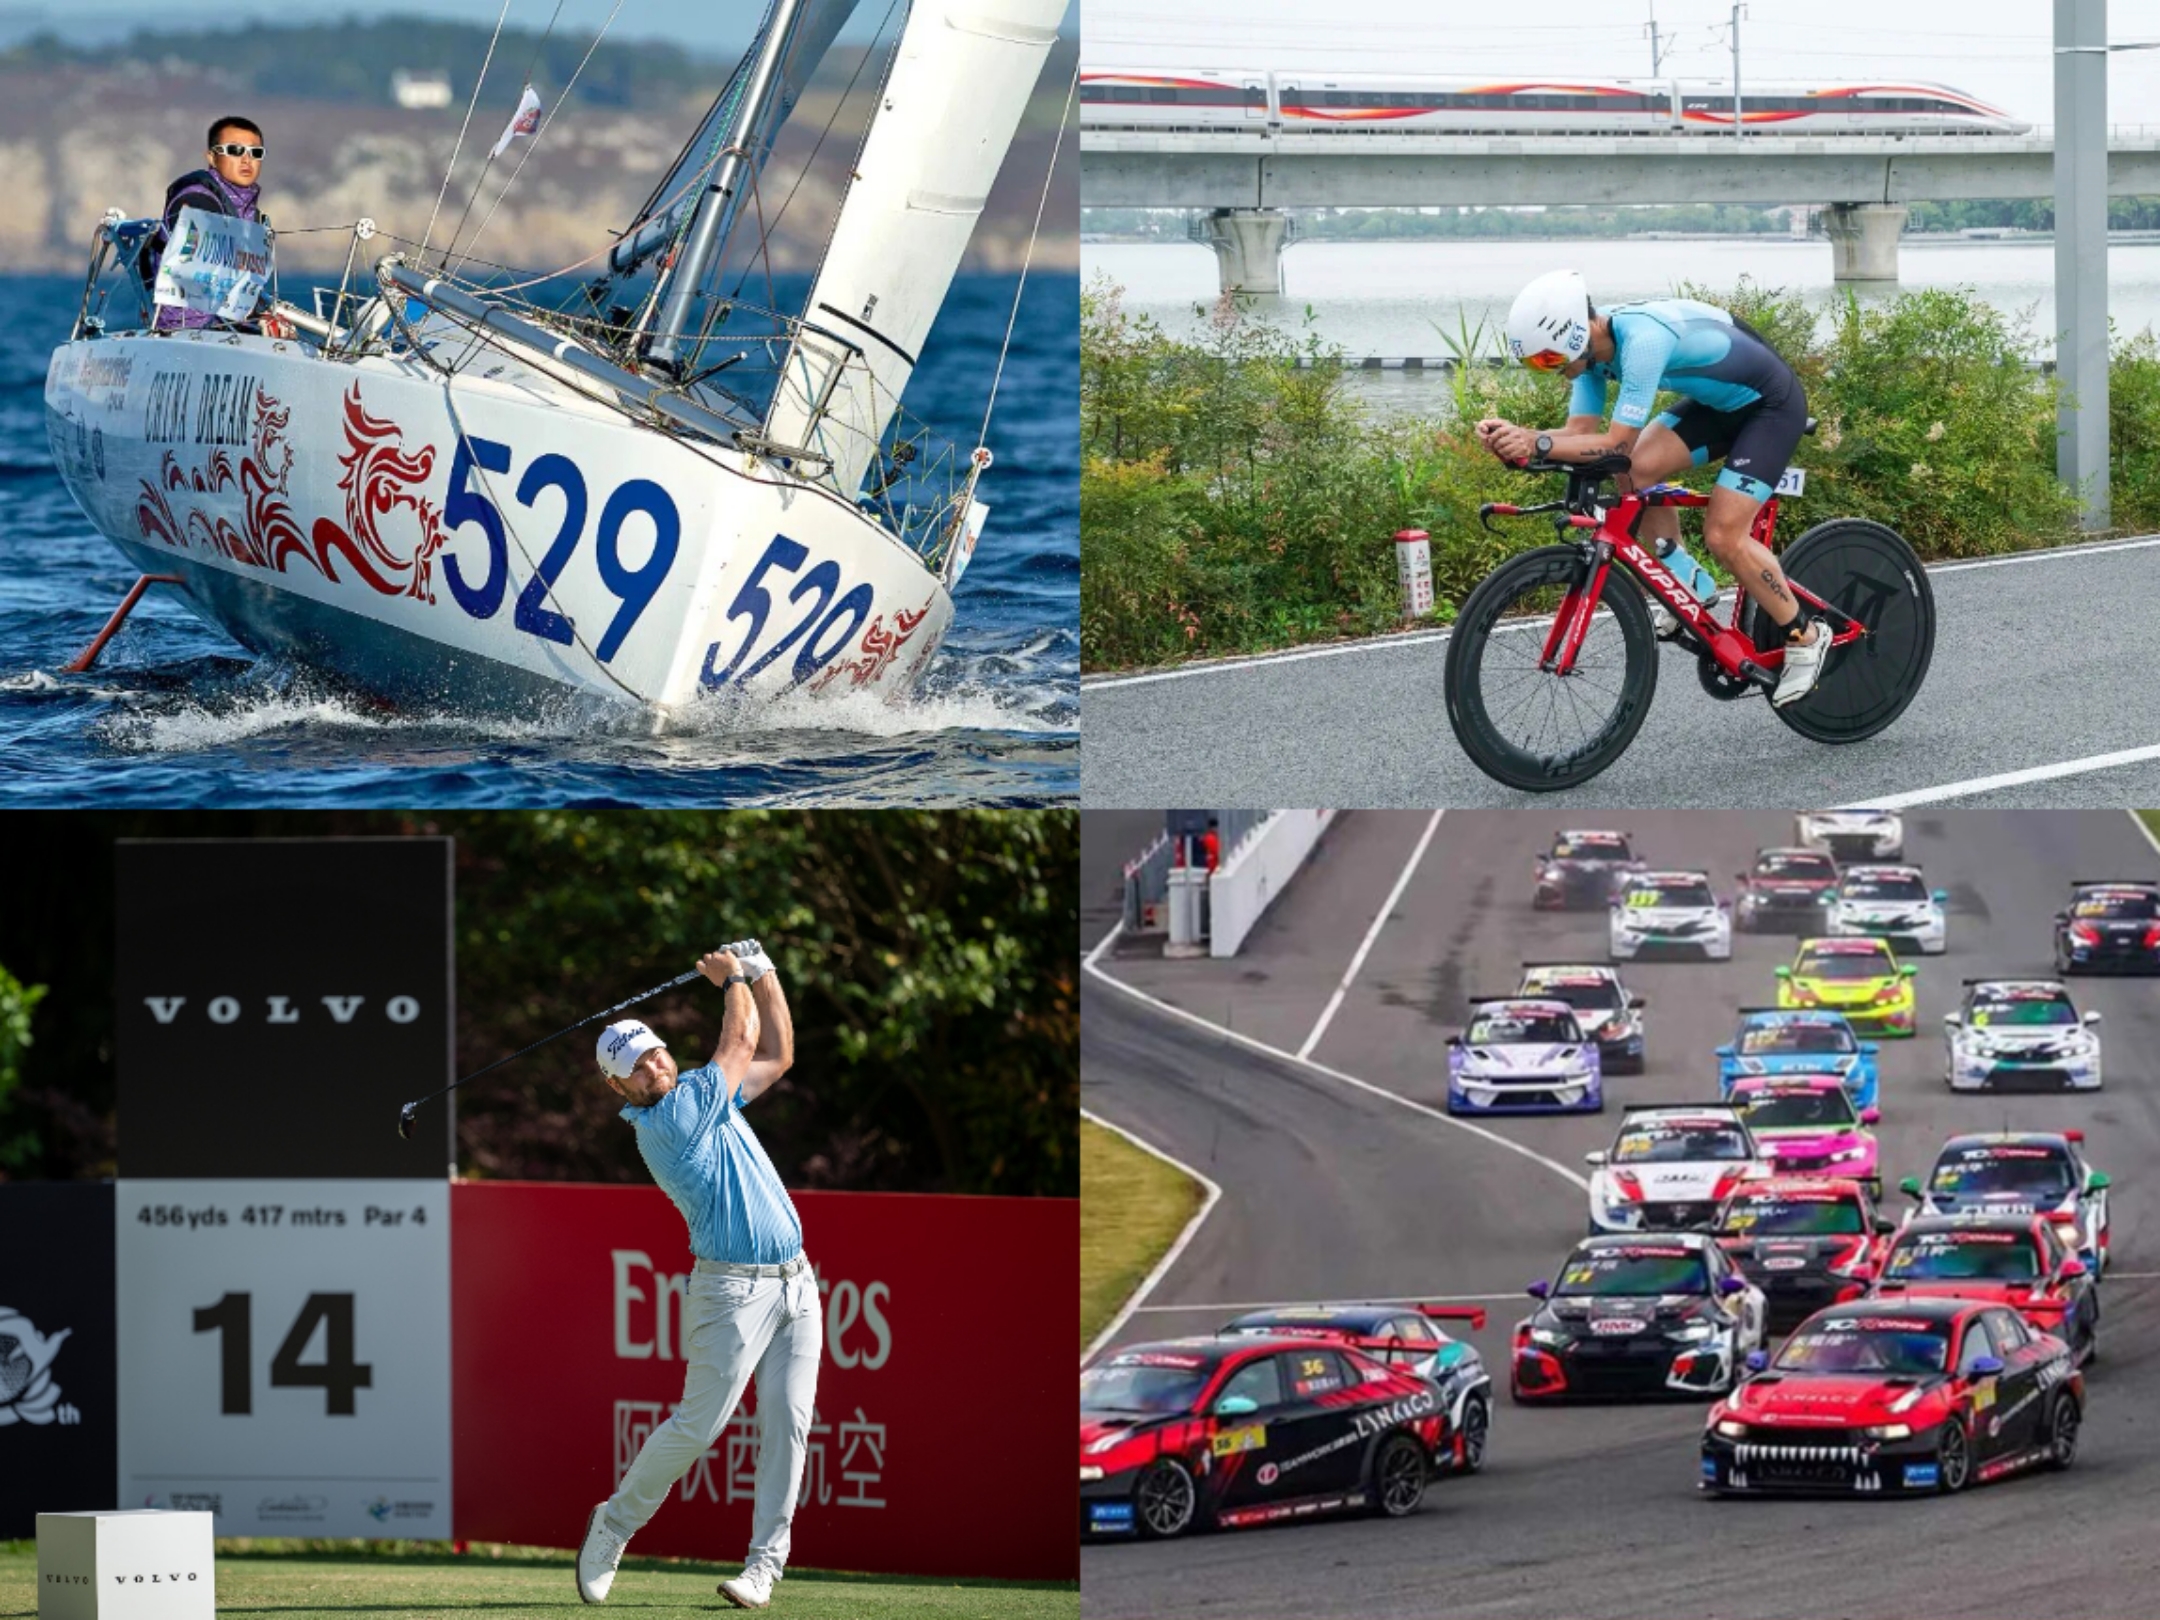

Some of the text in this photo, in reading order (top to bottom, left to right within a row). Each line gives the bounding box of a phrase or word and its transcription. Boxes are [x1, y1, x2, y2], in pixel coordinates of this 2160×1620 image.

[1568, 324, 1587, 351] 651
[144, 371, 192, 443] CHINA
[195, 374, 255, 446] DREAM
[441, 434, 680, 664] 529
[1622, 545, 1700, 622] SUPRA
[143, 995, 420, 1024] VOLVO
[241, 1205, 284, 1227] 417
[291, 1206, 347, 1227] mtrs
[363, 1205, 403, 1227] Par
[411, 1205, 427, 1227] 4
[191, 1290, 374, 1417] 14
[1301, 1360, 1325, 1376] 36
[57, 1402, 81, 1425] th
[114, 1572, 198, 1584] VOLVO
